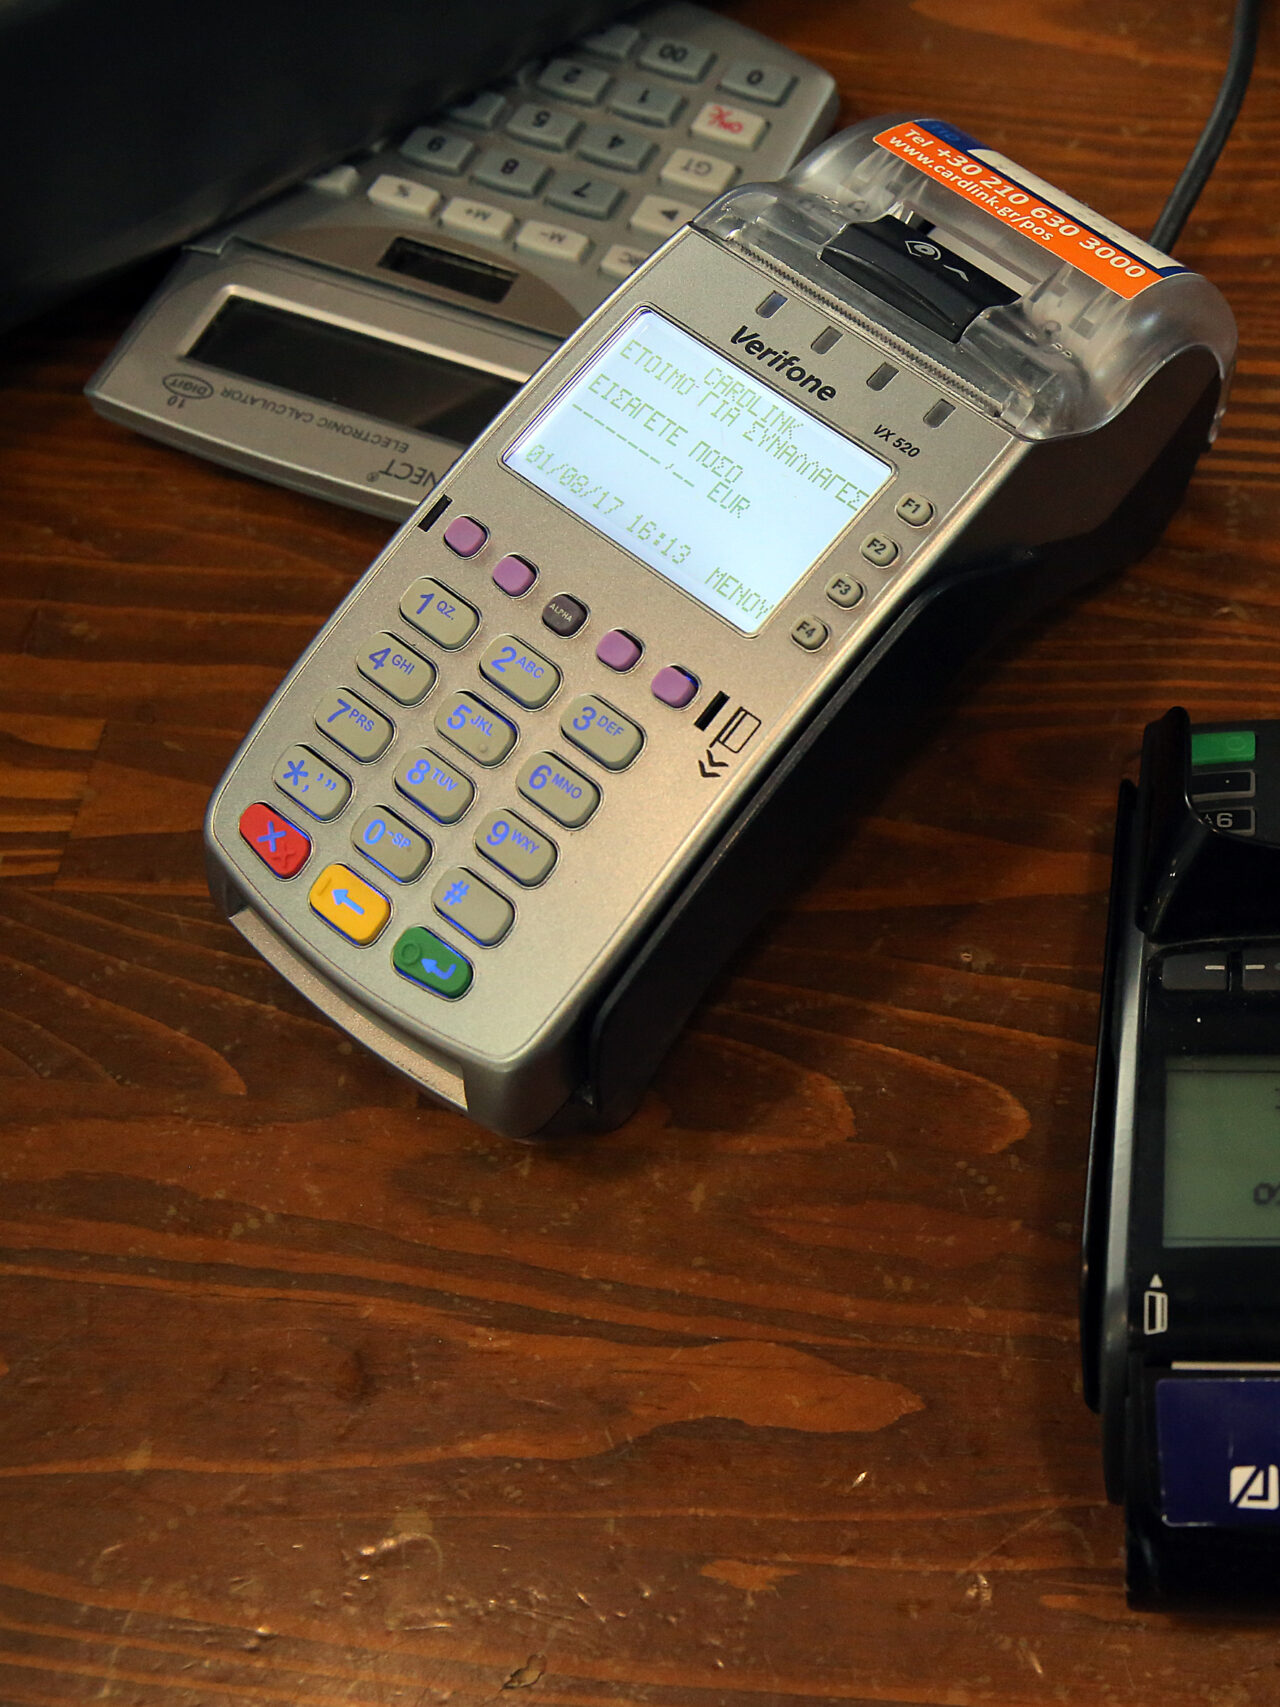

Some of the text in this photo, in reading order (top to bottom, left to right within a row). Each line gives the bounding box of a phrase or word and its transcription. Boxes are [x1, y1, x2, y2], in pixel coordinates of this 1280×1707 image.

[500, 158, 520, 175] 8
[681, 157, 713, 177] GT
[571, 181, 592, 198] 7
[888, 135, 1054, 242] www.cardlink.gr/pos
[903, 128, 934, 148] Tel
[936, 147, 984, 177] +30
[979, 175, 1030, 206] 210
[1029, 206, 1081, 238] 630
[1078, 236, 1148, 279] 3000
[730, 324, 838, 403] Verifone
[167, 376, 210, 396] DIGIT
[167, 394, 187, 410] 10
[219, 385, 411, 454] ELECTRONIC CALCULATOR
[872, 424, 921, 459] VX 520
[524, 443, 692, 566] 01/08/17 16:13
[706, 480, 752, 519] EUR
[902, 498, 921, 515] F1
[866, 538, 886, 555] F2
[832, 578, 852, 596] F3
[416, 592, 435, 615] 1
[549, 602, 574, 623] ALPHA
[796, 622, 815, 639] F4
[368, 646, 392, 670] 4
[490, 645, 517, 673] 2
[326, 698, 350, 724] 7
[446, 703, 472, 730] 5
[572, 706, 597, 732] 3
[405, 758, 431, 786] 8
[527, 763, 552, 790] 6
[363, 818, 387, 845] 0
[486, 820, 511, 846] 9
[1215, 812, 1234, 828] 9
